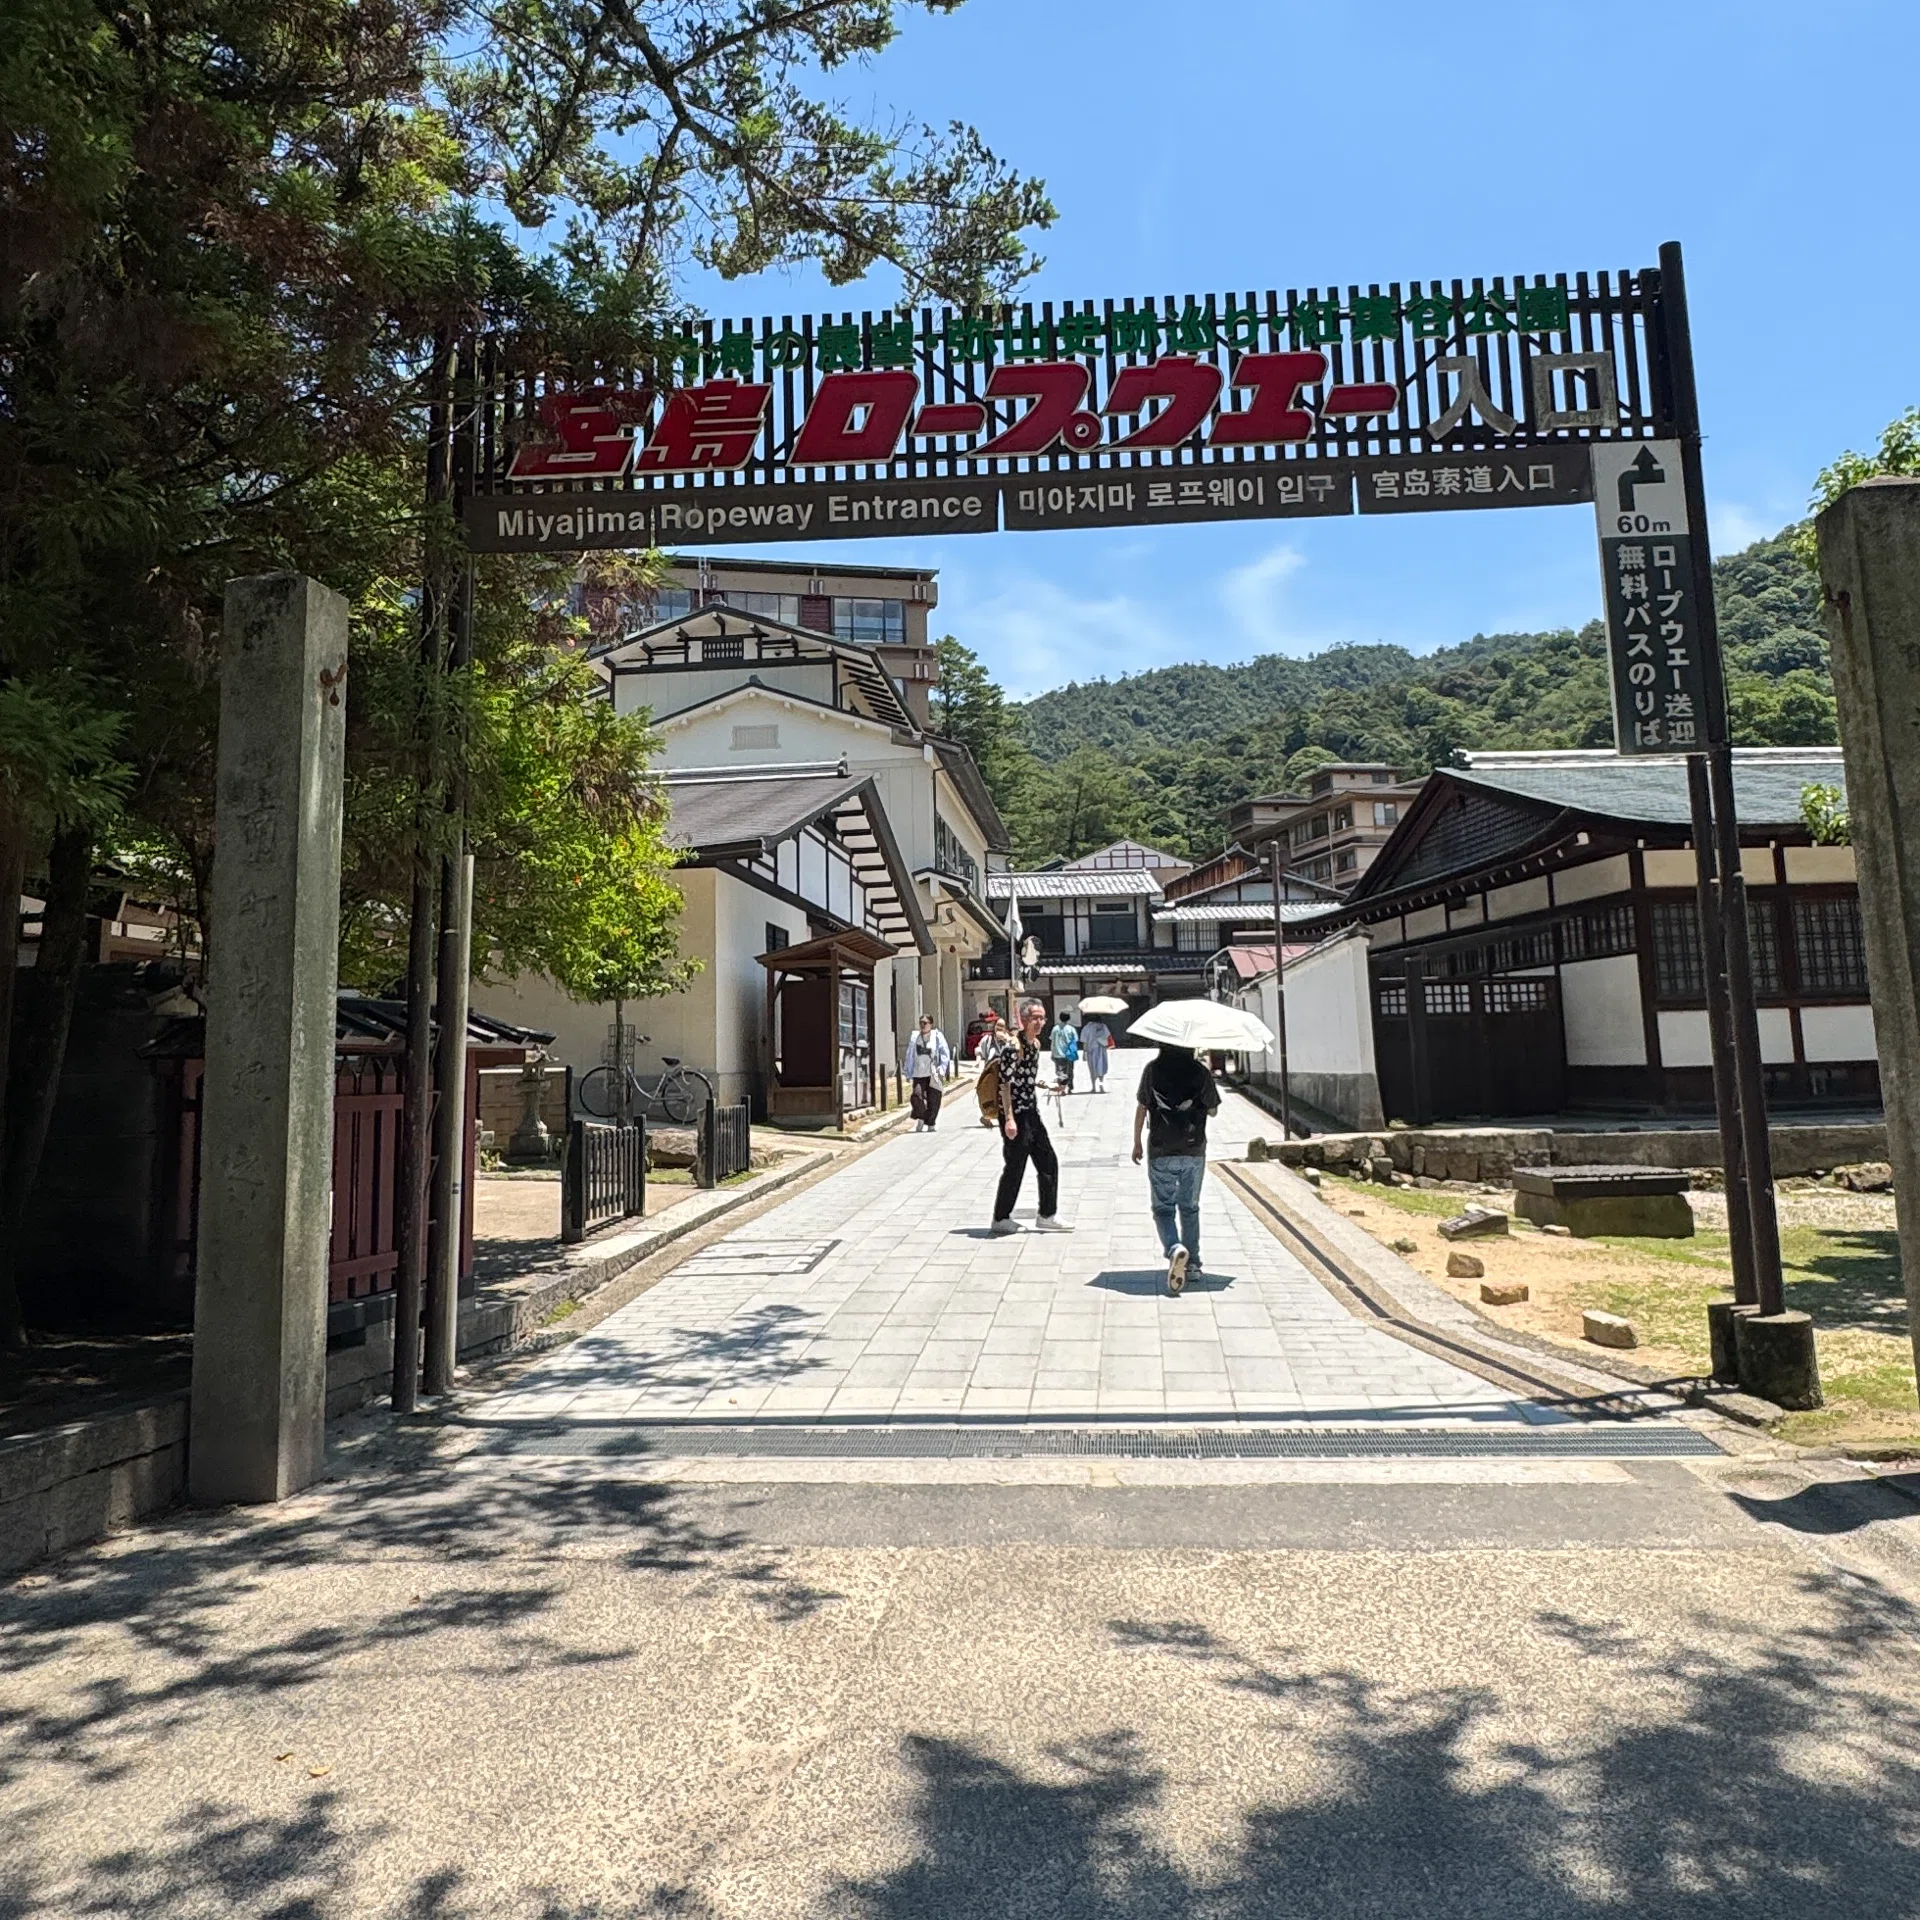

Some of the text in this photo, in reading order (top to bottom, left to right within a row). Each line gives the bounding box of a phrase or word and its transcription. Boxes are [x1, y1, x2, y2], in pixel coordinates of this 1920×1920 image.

[1426, 350, 1618, 440] 入口
[498, 495, 982, 542] Miyajima Ropeway Entrance
[1019, 475, 1336, 516] 미야지마 로프웨이 입구
[1617, 514, 1671, 534] 60m
[1616, 544, 1662, 746] 無料バスのりば
